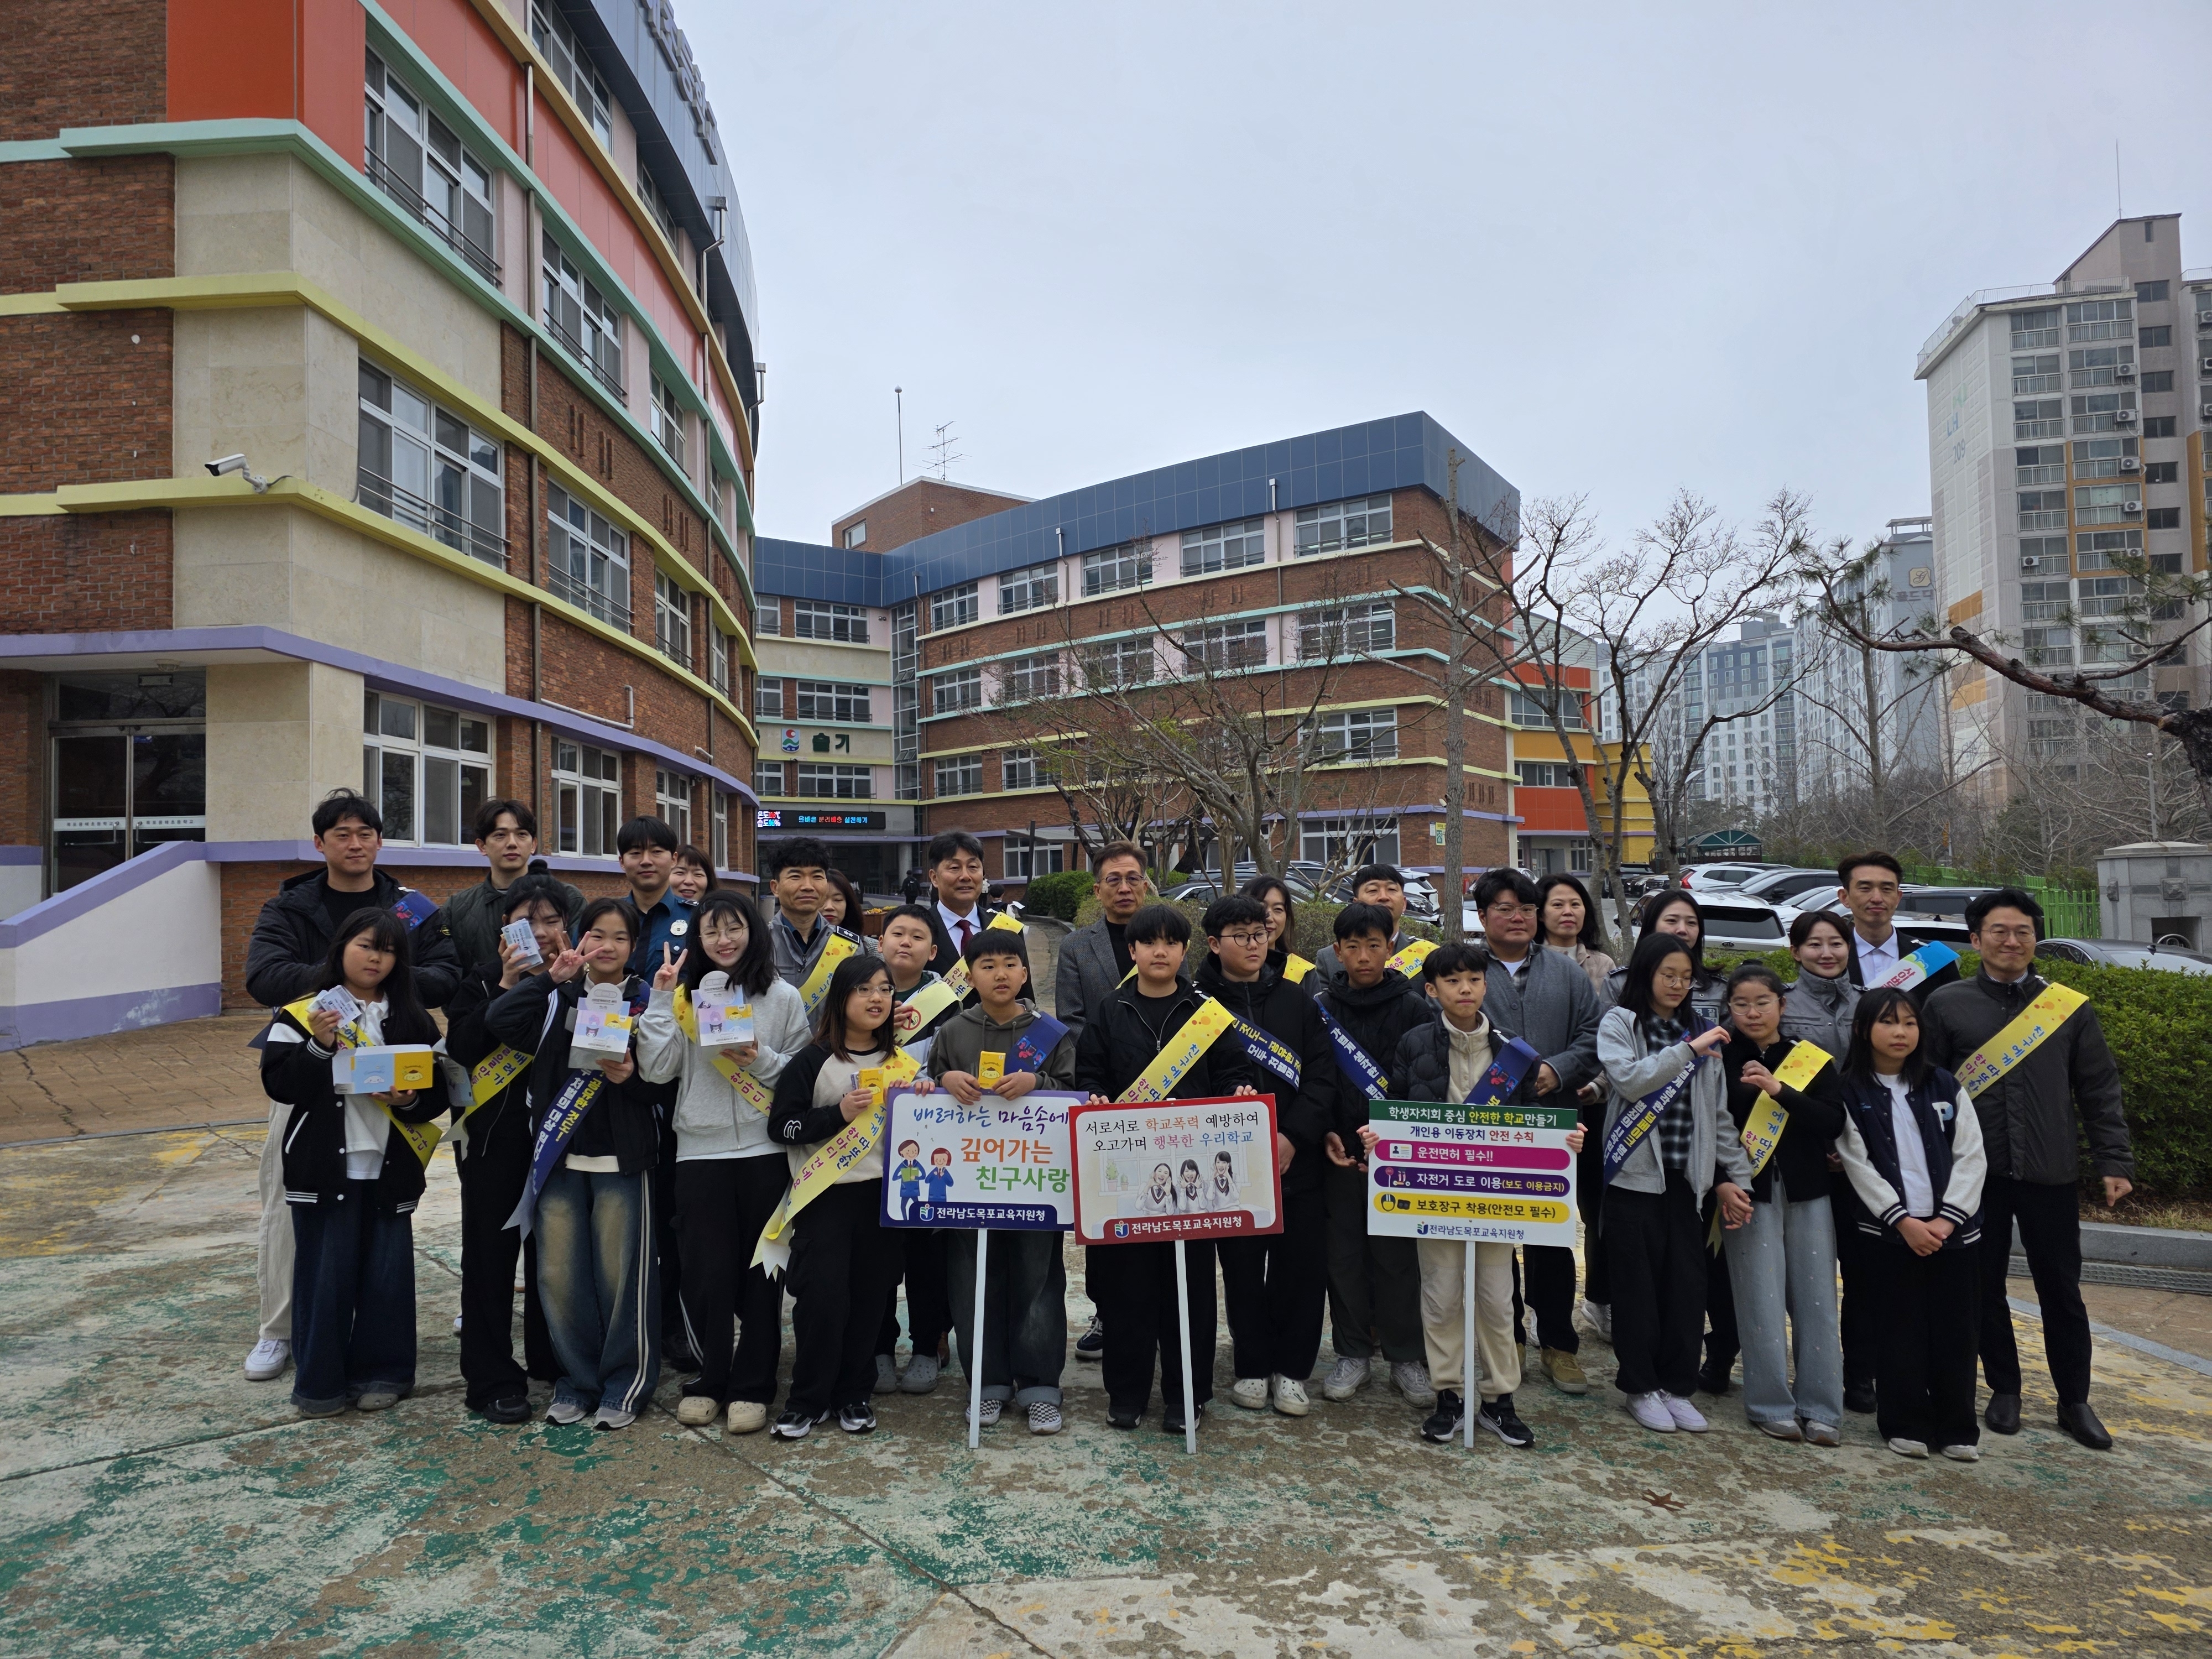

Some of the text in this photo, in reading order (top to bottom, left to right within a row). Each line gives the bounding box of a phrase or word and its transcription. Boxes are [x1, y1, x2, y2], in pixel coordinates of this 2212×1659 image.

[1947, 412, 1959, 436] LH
[1953, 438, 1966, 465] 209
[1247, 1044, 1267, 1061] 모두
[1268, 1056, 1295, 1079] 처벌의
[1267, 1041, 1294, 1062] 공유한
[1330, 1026, 1356, 1053] 가볍게
[1354, 1051, 1379, 1079] 생각한
[1969, 1025, 2044, 1093] 친구에게 따뜻한
[494, 1052, 528, 1086] 배려가
[1162, 1044, 1200, 1089] 친구에게
[556, 1077, 585, 1109] 처벌의
[574, 1077, 602, 1110] 공유한
[1652, 1086, 1677, 1114] 생각한
[555, 1110, 580, 1142] 것도!
[914, 1103, 1069, 1135] 배려하는 마음속에
[1085, 1110, 1259, 1137] 서로서로 학교폭력 예방하여
[1388, 1106, 1557, 1127] 학생자치회 중심 안전한 학교만들기
[1621, 1100, 1647, 1128] 범죄의
[1932, 1102, 1954, 1132] P
[1093, 1130, 1254, 1152] 오고가며 행복한 우리학교
[1410, 1125, 1534, 1143] 개인용 이동장치 안전 수칙
[1624, 1110, 1657, 1147] 딥페이크
[837, 1136, 870, 1170] 따뜻한
[961, 1138, 1053, 1164] 깊어가는
[1417, 1146, 1494, 1162] 운전면허 필수!!
[1611, 1143, 1627, 1164] 영상
[794, 1156, 824, 1190] 건네요
[975, 1166, 1071, 1193] 친구사랑
[1417, 1173, 1449, 1187] 자전거
[1453, 1175, 1475, 1188] 도로
[1526, 1179, 1565, 1193] 이용금지)
[936, 1206, 1046, 1222] 전라남도목포교육지원청
[1416, 1199, 1556, 1219] 보호장구 착용(안전모 필수)
[1131, 1216, 1243, 1235] 전라남도목포교육지원청
[1429, 1224, 1525, 1241] 전라남도목포교육지원청
